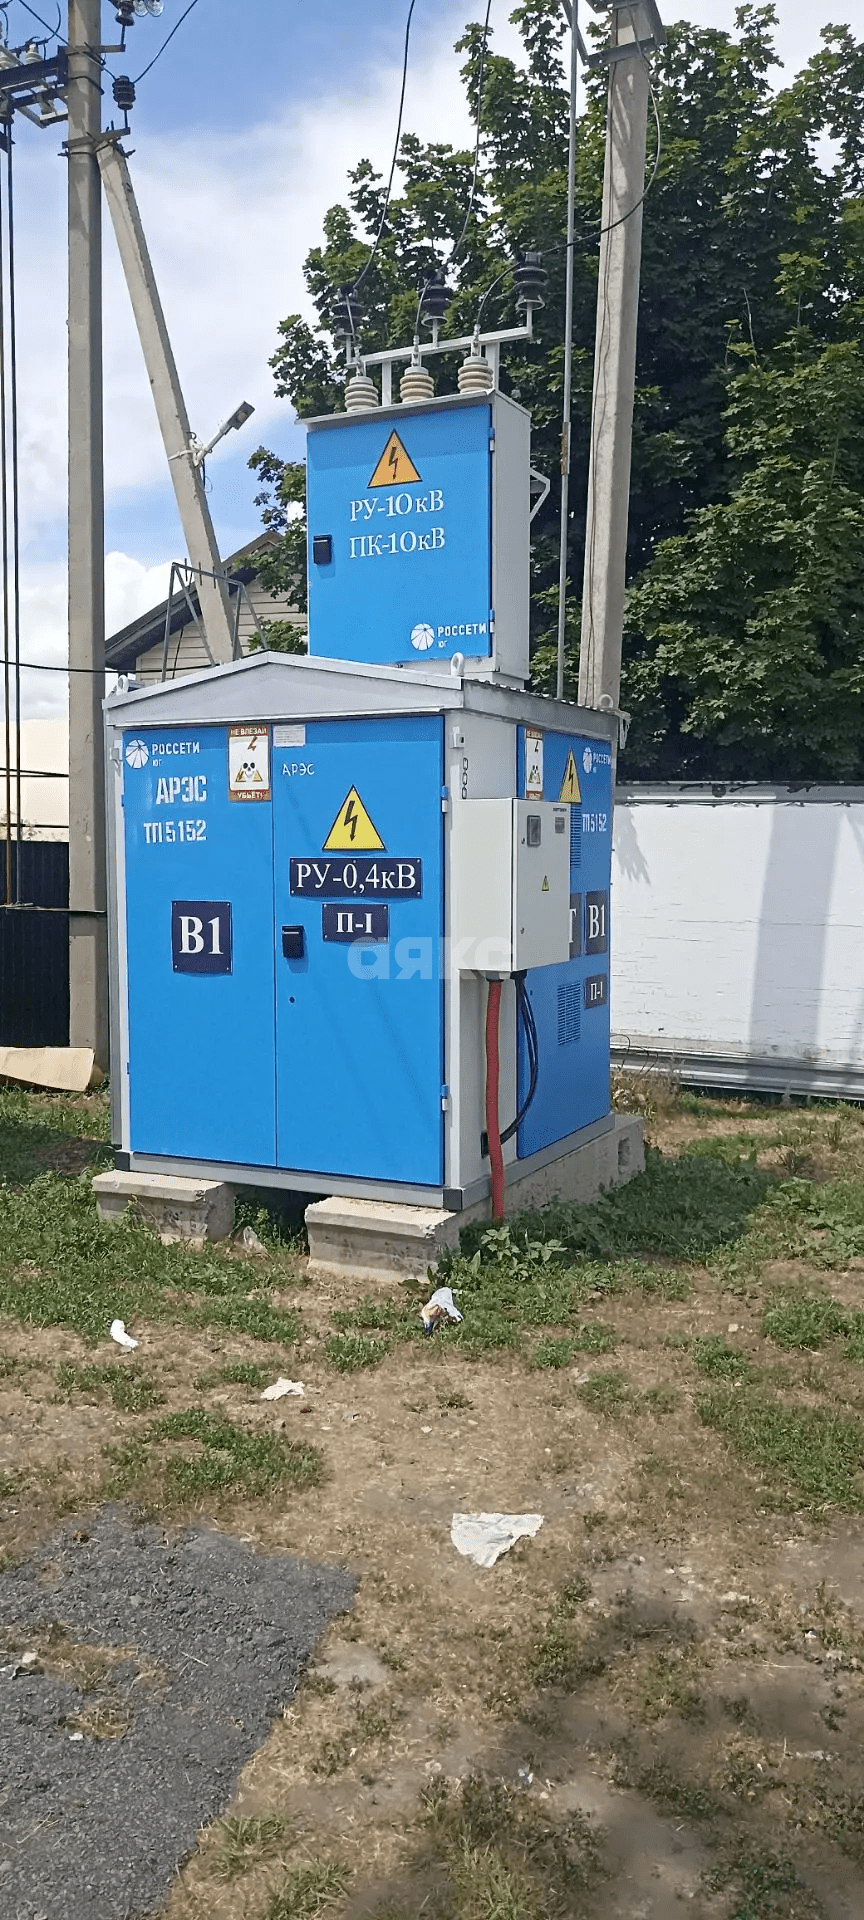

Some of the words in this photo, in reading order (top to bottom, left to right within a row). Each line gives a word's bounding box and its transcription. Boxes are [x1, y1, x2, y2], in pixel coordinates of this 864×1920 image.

[349, 527, 445, 559] ПК-10кВ
[437, 623, 487, 638] РОССЕТИ
[152, 742, 200, 755] РОССЕТИ
[282, 763, 315, 777] АРЭС
[156, 775, 207, 805] АРЭС
[296, 863, 417, 894] РУ-0,4кВ
[178, 915, 225, 955] В1
[588, 904, 606, 939] В1
